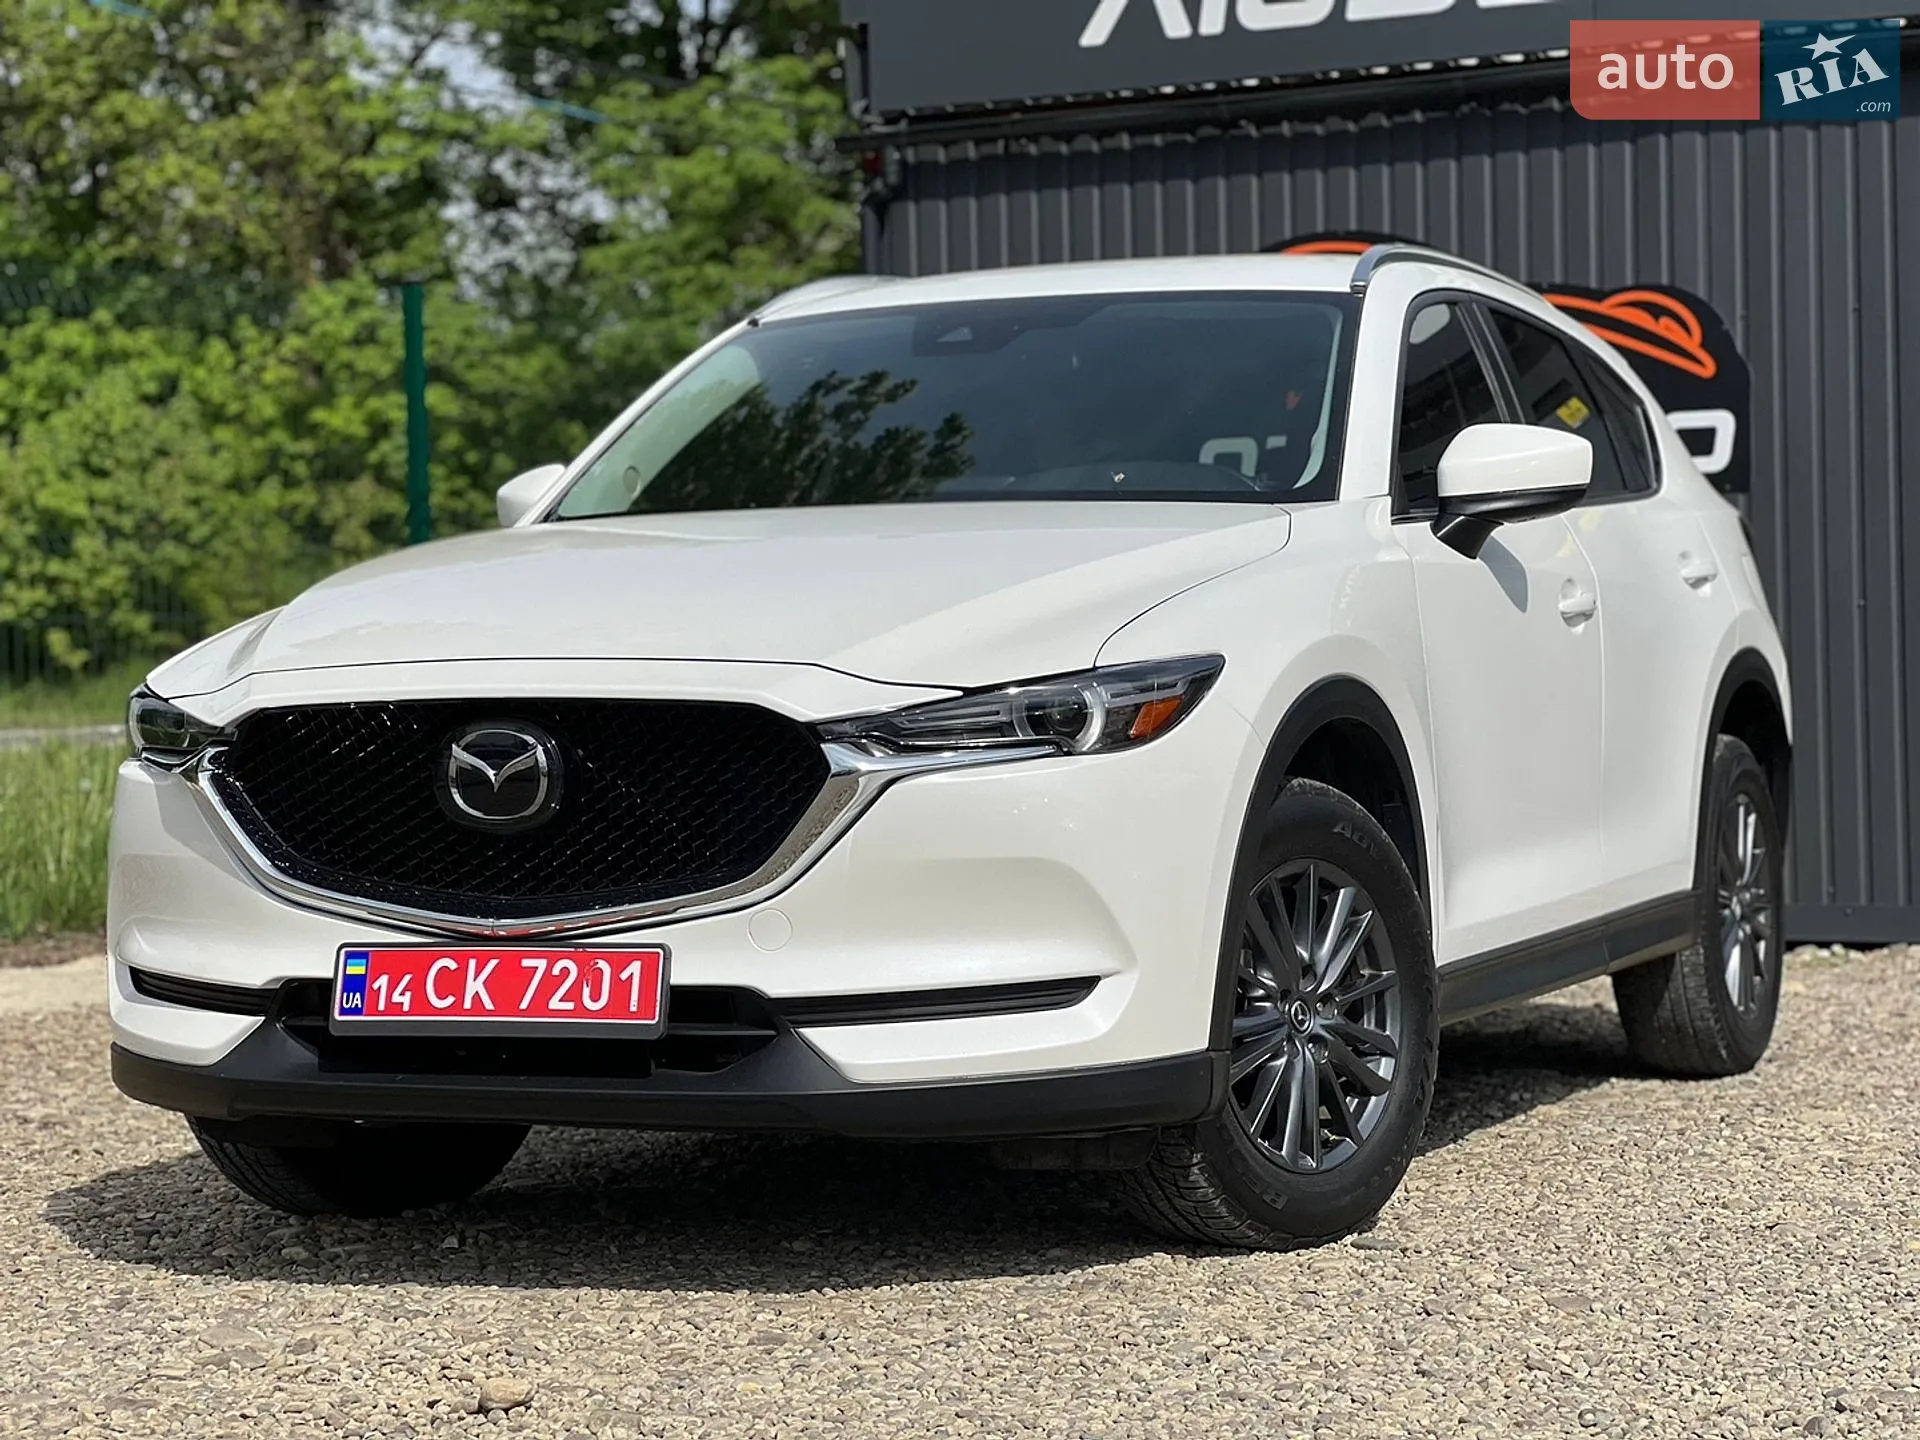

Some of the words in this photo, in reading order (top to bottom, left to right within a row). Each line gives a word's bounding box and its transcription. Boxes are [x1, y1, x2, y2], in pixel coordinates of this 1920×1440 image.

[342, 992, 362, 1009] UA
[370, 973, 414, 1013] 14
[424, 957, 501, 1011] CK
[517, 957, 643, 1013] 7201
